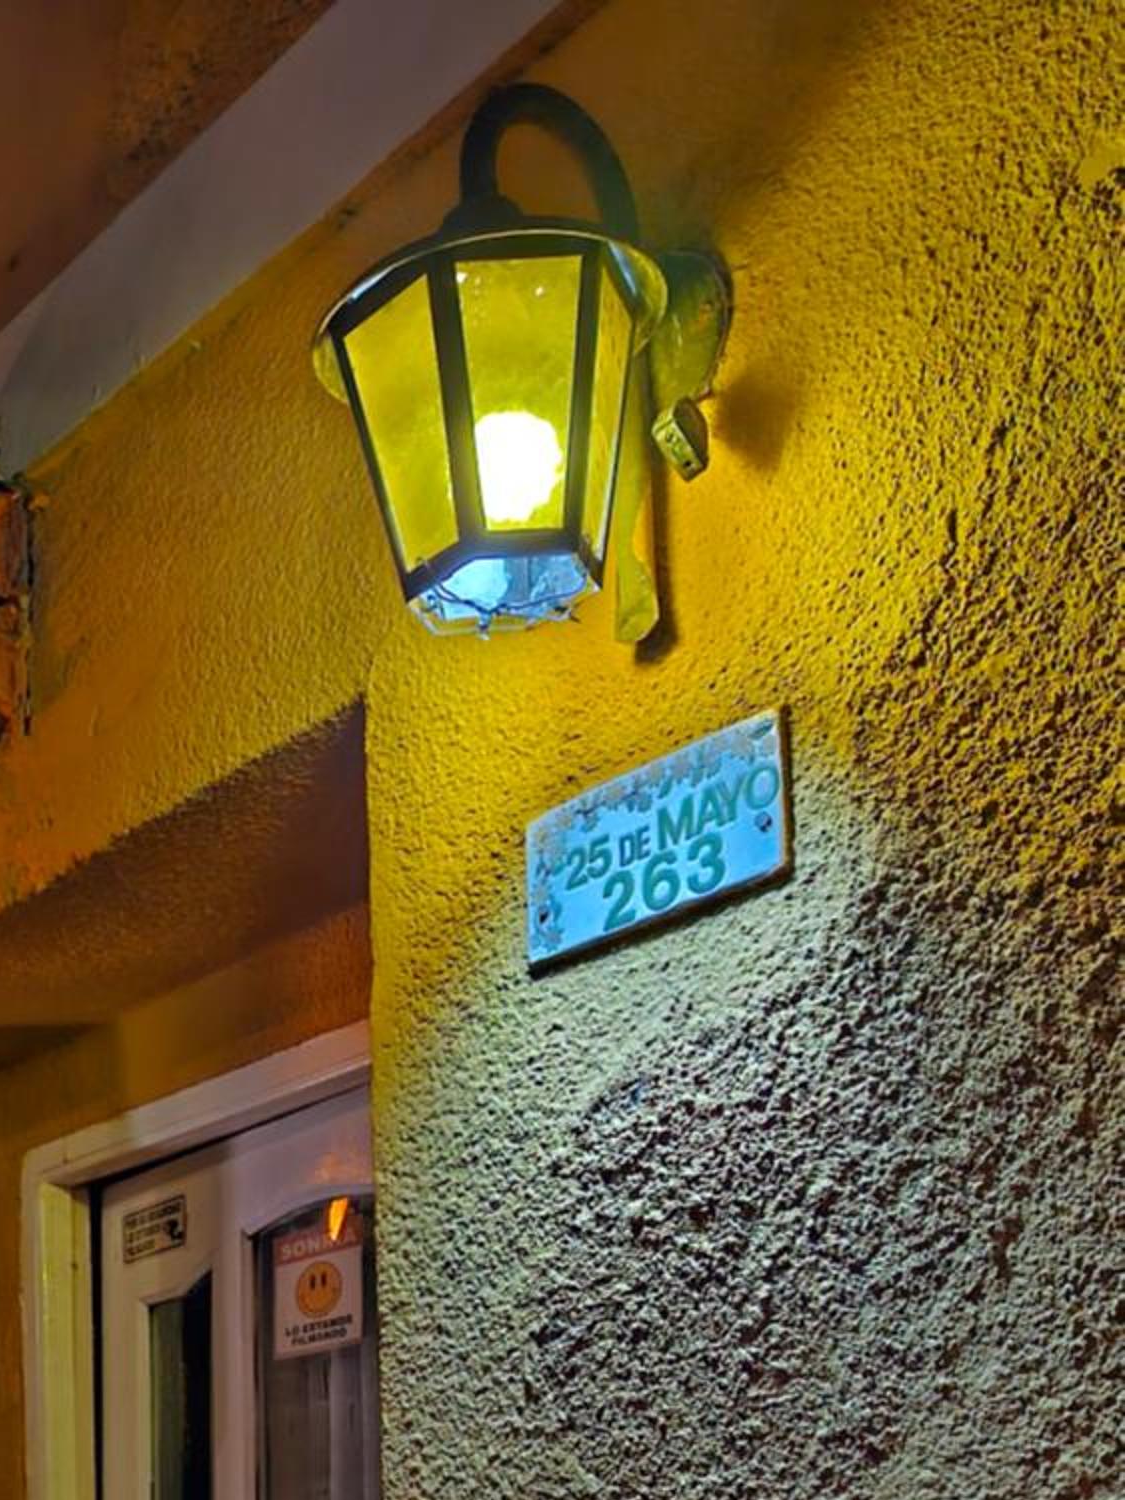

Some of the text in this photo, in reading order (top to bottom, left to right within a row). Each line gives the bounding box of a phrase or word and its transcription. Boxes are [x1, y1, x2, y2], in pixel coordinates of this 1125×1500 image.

[564, 764, 781, 891] 25 DE MAYO
[602, 831, 726, 933] 263
